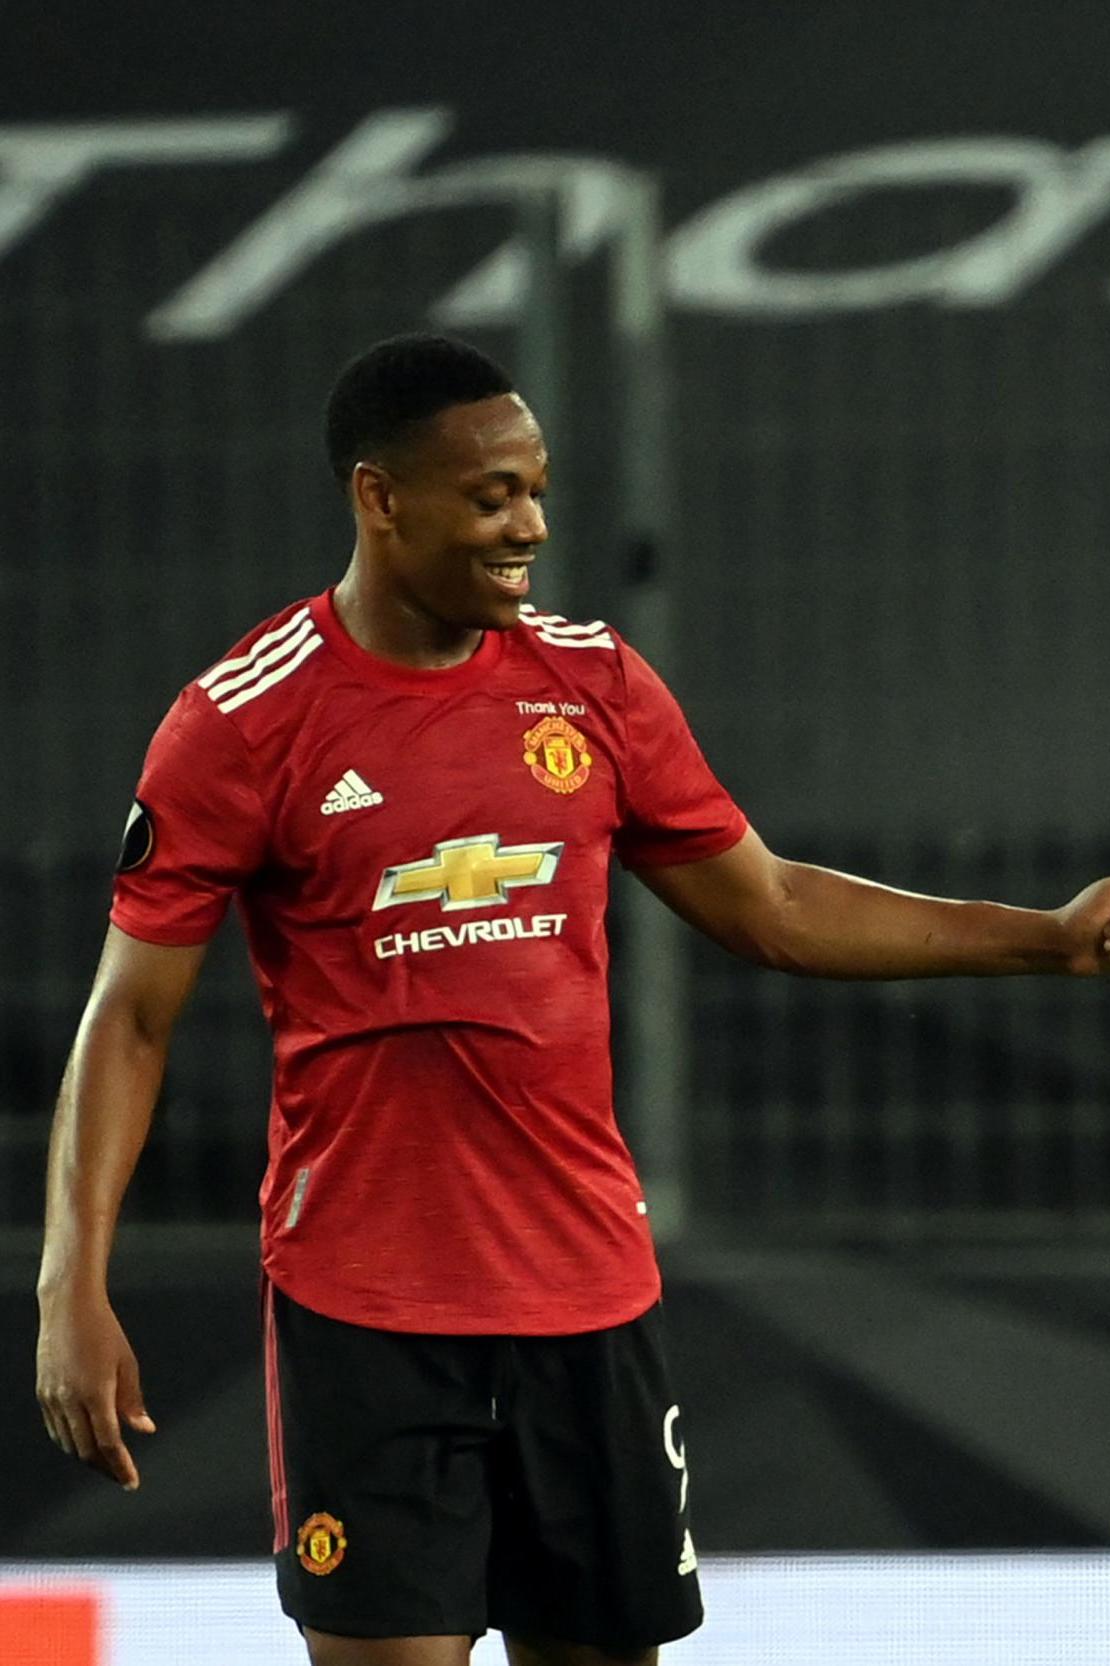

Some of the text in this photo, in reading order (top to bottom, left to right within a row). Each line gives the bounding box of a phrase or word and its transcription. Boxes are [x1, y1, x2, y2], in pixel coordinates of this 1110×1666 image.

[515, 701, 586, 716] Thank You
[320, 789, 383, 816] adidas
[374, 913, 567, 960] CHEVROLET
